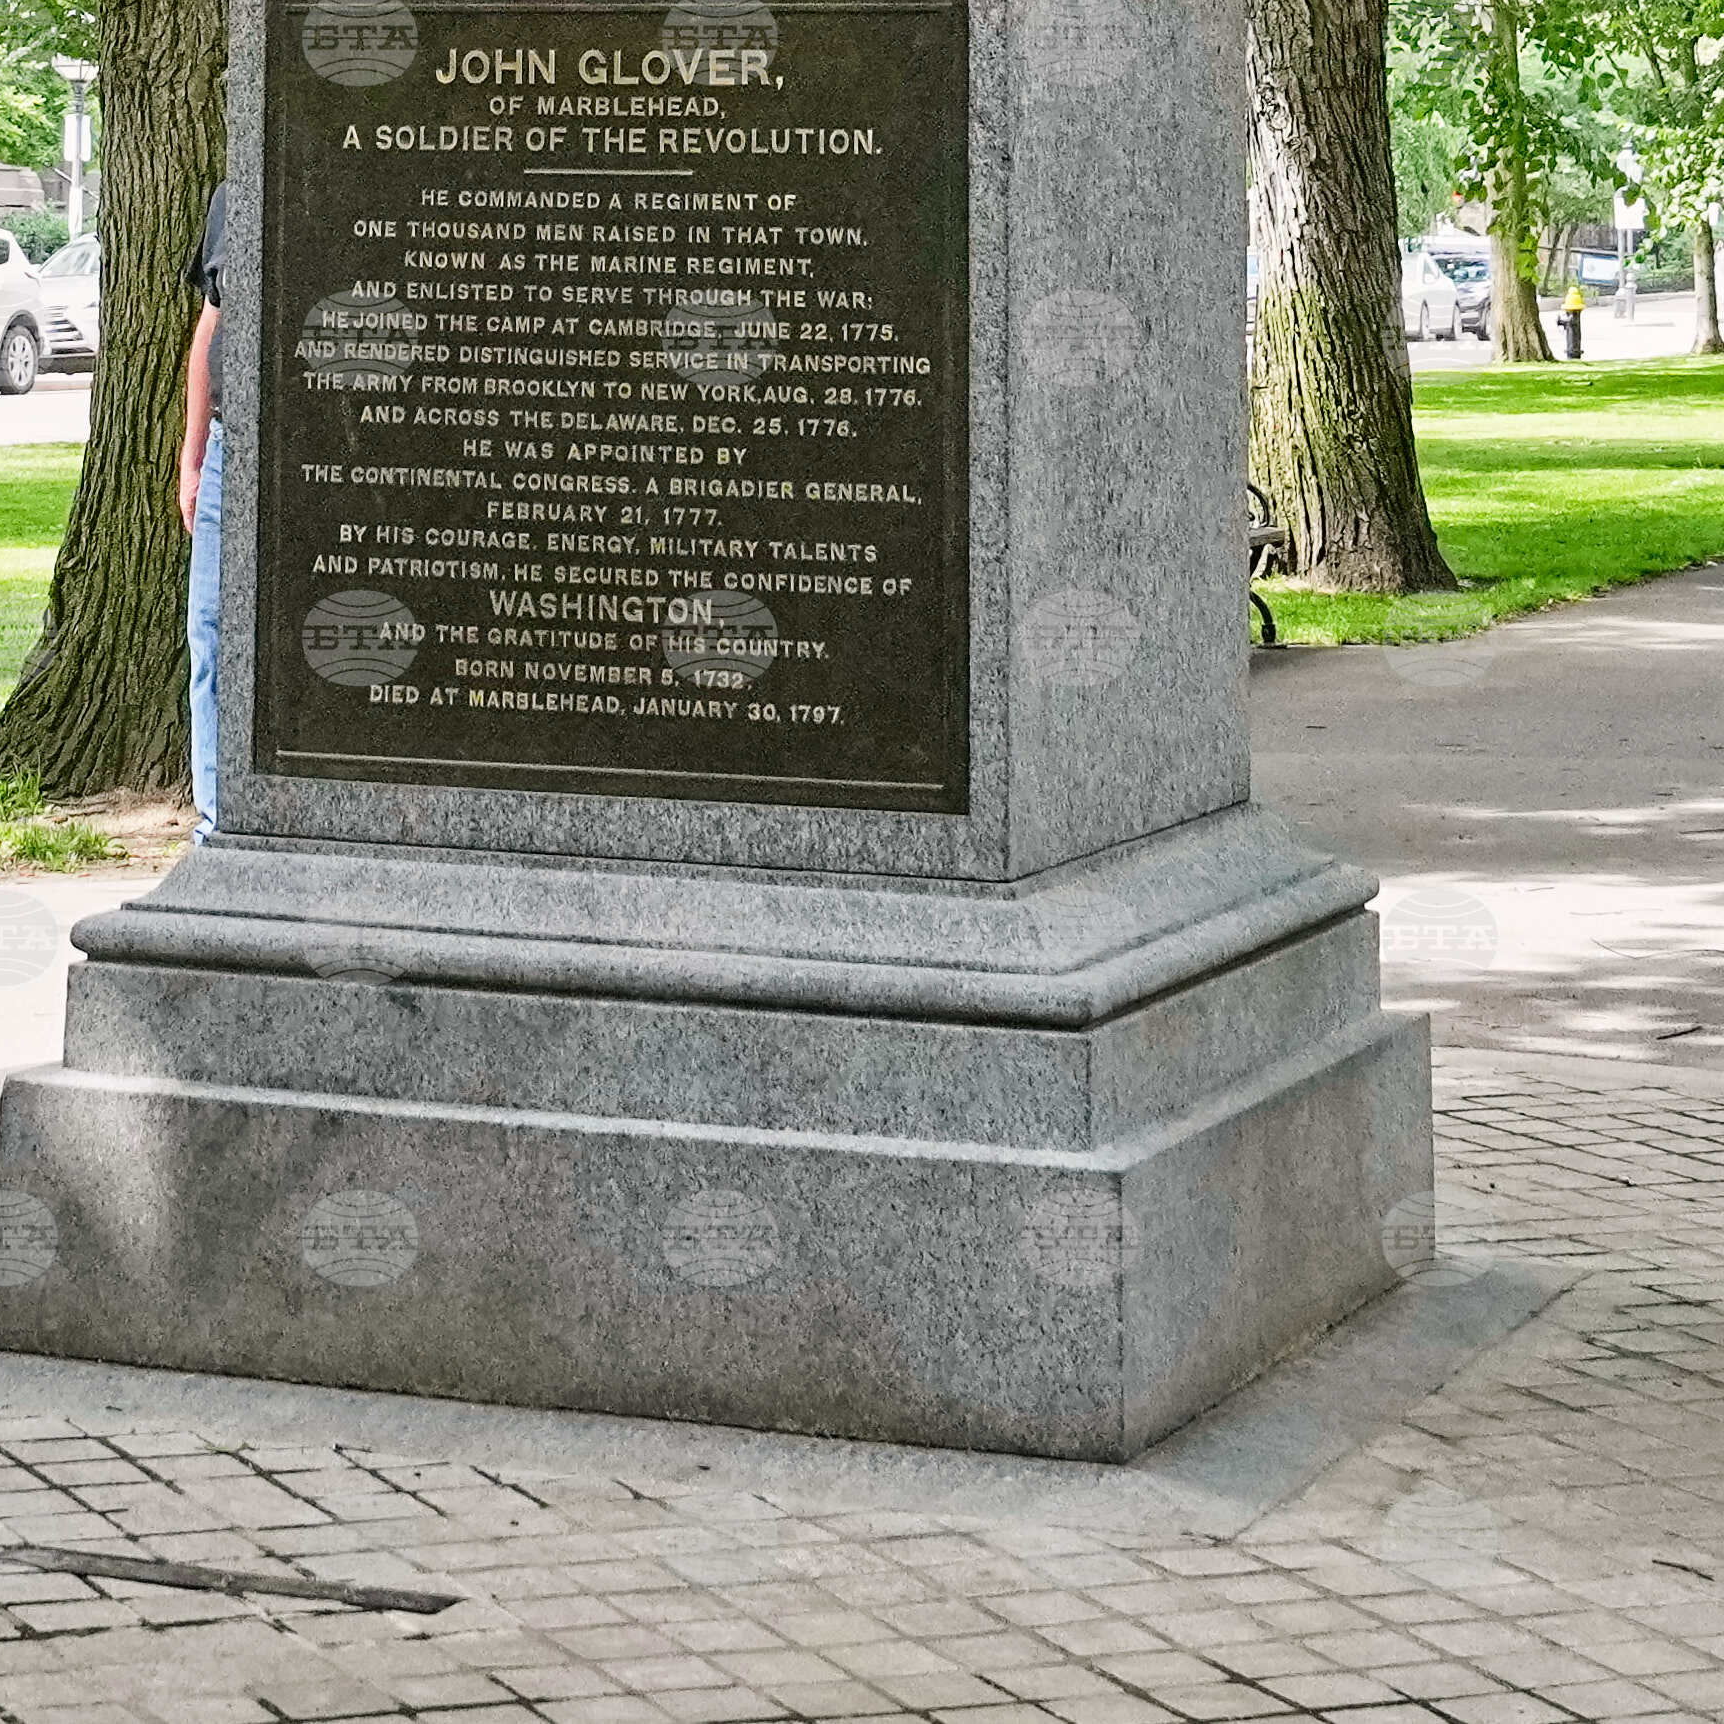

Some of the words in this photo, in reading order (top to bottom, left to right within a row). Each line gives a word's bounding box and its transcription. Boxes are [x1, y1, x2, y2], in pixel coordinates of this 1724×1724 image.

[436, 48, 556, 85] JOHN
[578, 49, 783, 90] GLOVER,
[489, 96, 524, 115] OF
[537, 96, 726, 119] MARBLEHEAD,
[343, 124, 362, 150] A
[376, 125, 513, 152] SOLDIER
[525, 127, 567, 152] OF
[582, 127, 646, 153] THE
[659, 127, 883, 155] REVOLUTION.
[421, 190, 449, 206] HE
[459, 190, 600, 209] COMMANDED
[608, 194, 622, 210] A
[635, 193, 758, 210] REGIMENT
[767, 194, 797, 211] OF
[354, 221, 396, 237] ONE
[408, 222, 525, 240] THOUSAND
[536, 224, 583, 241] MEN
[593, 225, 676, 243] RAISED
[688, 226, 710, 244] IN
[723, 226, 782, 245] THAT
[404, 252, 485, 269] KNOWN
[500, 253, 525, 270] AS
[535, 254, 579, 271] THE
[591, 255, 676, 274] MARINE
[351, 281, 396, 299] AND
[407, 282, 513, 301] ENLISTED
[525, 285, 552, 301] TO
[562, 286, 632, 304] SERVE
[643, 288, 751, 306] THROUGH
[761, 290, 806, 307] THE
[322, 310, 348, 328] HE
[352, 312, 427, 331] JOINED
[435, 314, 477, 332] THE
[487, 315, 545, 333] CAMP
[552, 317, 579, 335] AT
[733, 321, 790, 340] JUNE
[294, 341, 335, 359] AND
[344, 342, 449, 362] RENDERED
[459, 346, 621, 367] DISTINGUISHED
[629, 351, 718, 369] SERVICE
[727, 352, 748, 370] IN
[758, 353, 931, 374] TRANSPORTING
[304, 372, 343, 390] THE
[352, 374, 412, 392] ARMY
[422, 376, 477, 394] FROM
[484, 378, 595, 398] BROOKLYN
[604, 382, 631, 399] TO
[641, 383, 687, 400] NEW
[360, 406, 404, 423] AND
[414, 408, 499, 426] ACROSS
[510, 411, 553, 428] THE
[693, 415, 741, 434] DEC.
[463, 439, 492, 457] HE
[505, 441, 554, 459] WAS
[568, 443, 703, 464] APPOINTED
[717, 447, 747, 465] BY
[301, 464, 342, 482] THE
[351, 466, 502, 489] CONTINENTAL
[645, 478, 659, 495] A
[670, 478, 794, 499] BRIGADIER
[487, 502, 607, 522] FEBRUARY
[664, 508, 722, 526] 1777.
[340, 524, 367, 543] BY
[377, 525, 414, 544] HIS
[650, 537, 758, 558] MILITARY
[769, 541, 876, 562] TALENTS
[313, 555, 357, 573] AND
[515, 564, 542, 582] HE
[554, 565, 658, 586] SECURED
[668, 569, 713, 588] THE
[724, 572, 873, 595] CONFIDENCE
[883, 577, 913, 596] OF
[490, 590, 724, 629] WASHINGTON,
[379, 622, 426, 642] AND
[435, 624, 478, 644] THE
[488, 626, 618, 650] GRATITUDE
[629, 634, 658, 652] OF
[669, 637, 705, 653] HIS
[455, 658, 514, 678] BORN
[525, 661, 652, 685] NOVEMBER
[370, 685, 419, 704] DIED
[430, 687, 459, 705] AT
[469, 690, 626, 715] MARBLEHEAD,
[634, 696, 737, 719] JANUARY
